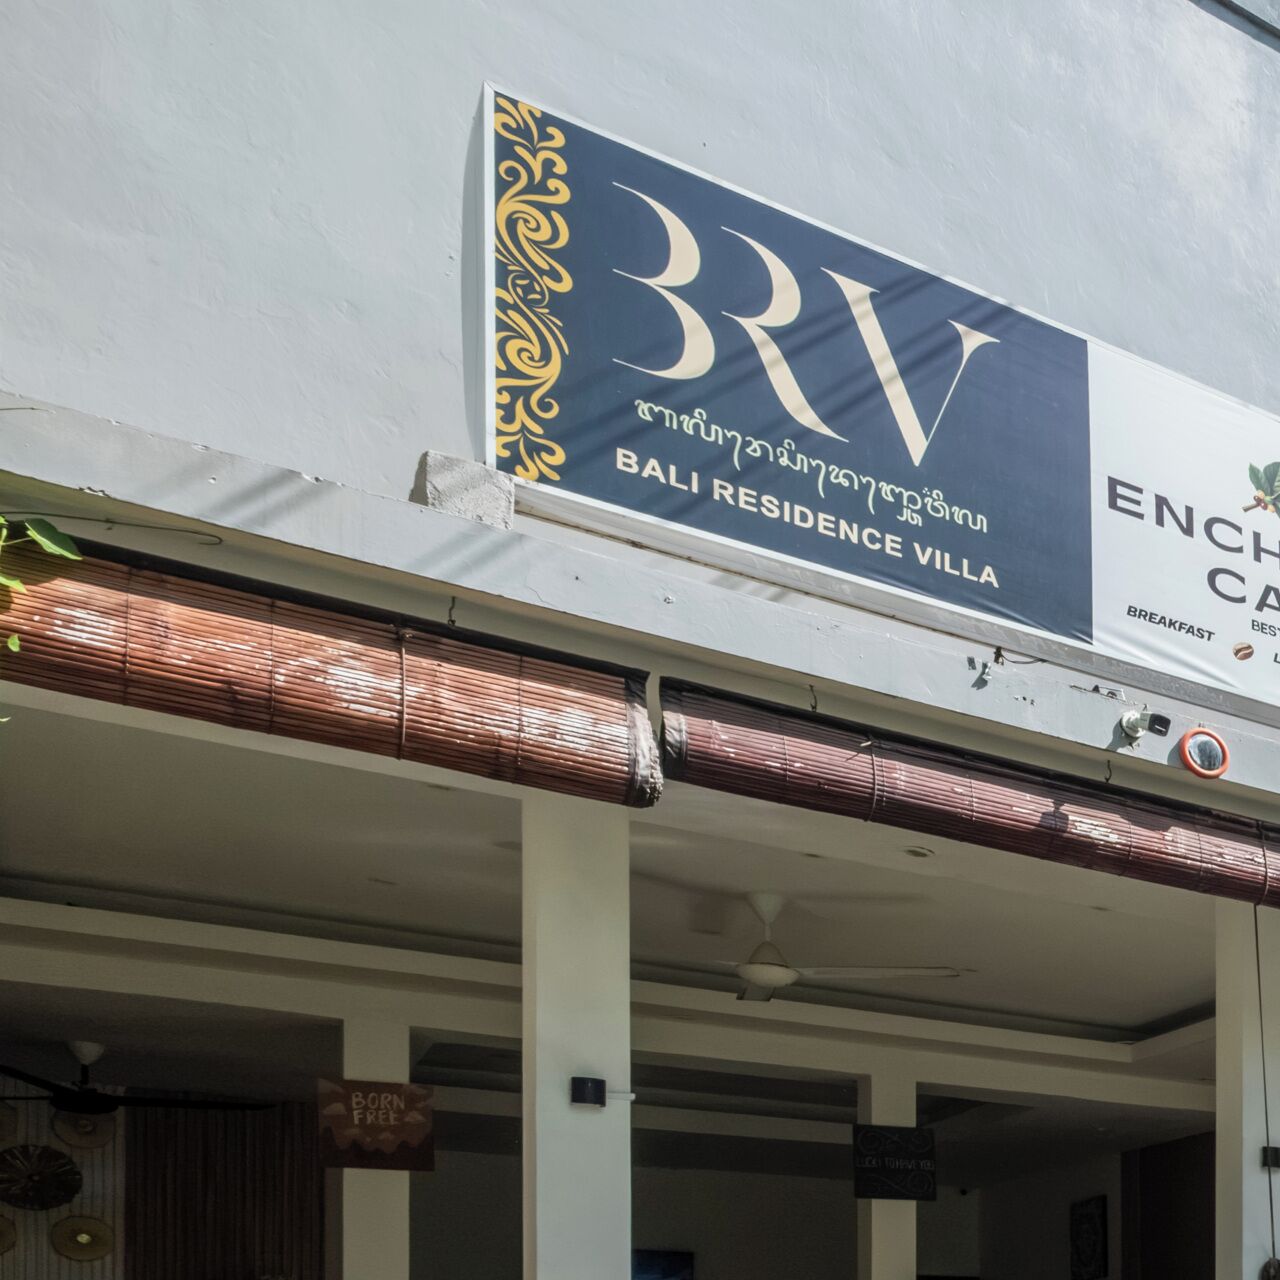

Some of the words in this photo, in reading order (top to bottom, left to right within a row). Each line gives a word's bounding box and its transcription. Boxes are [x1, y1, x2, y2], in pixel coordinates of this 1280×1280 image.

[616, 447, 699, 494] BALI
[712, 478, 903, 558] RESIDENCE
[913, 541, 1000, 589] VILLA
[1126, 604, 1216, 643] BREAKFAST
[351, 1092, 405, 1109] BORN
[353, 1109, 400, 1125] FREE
